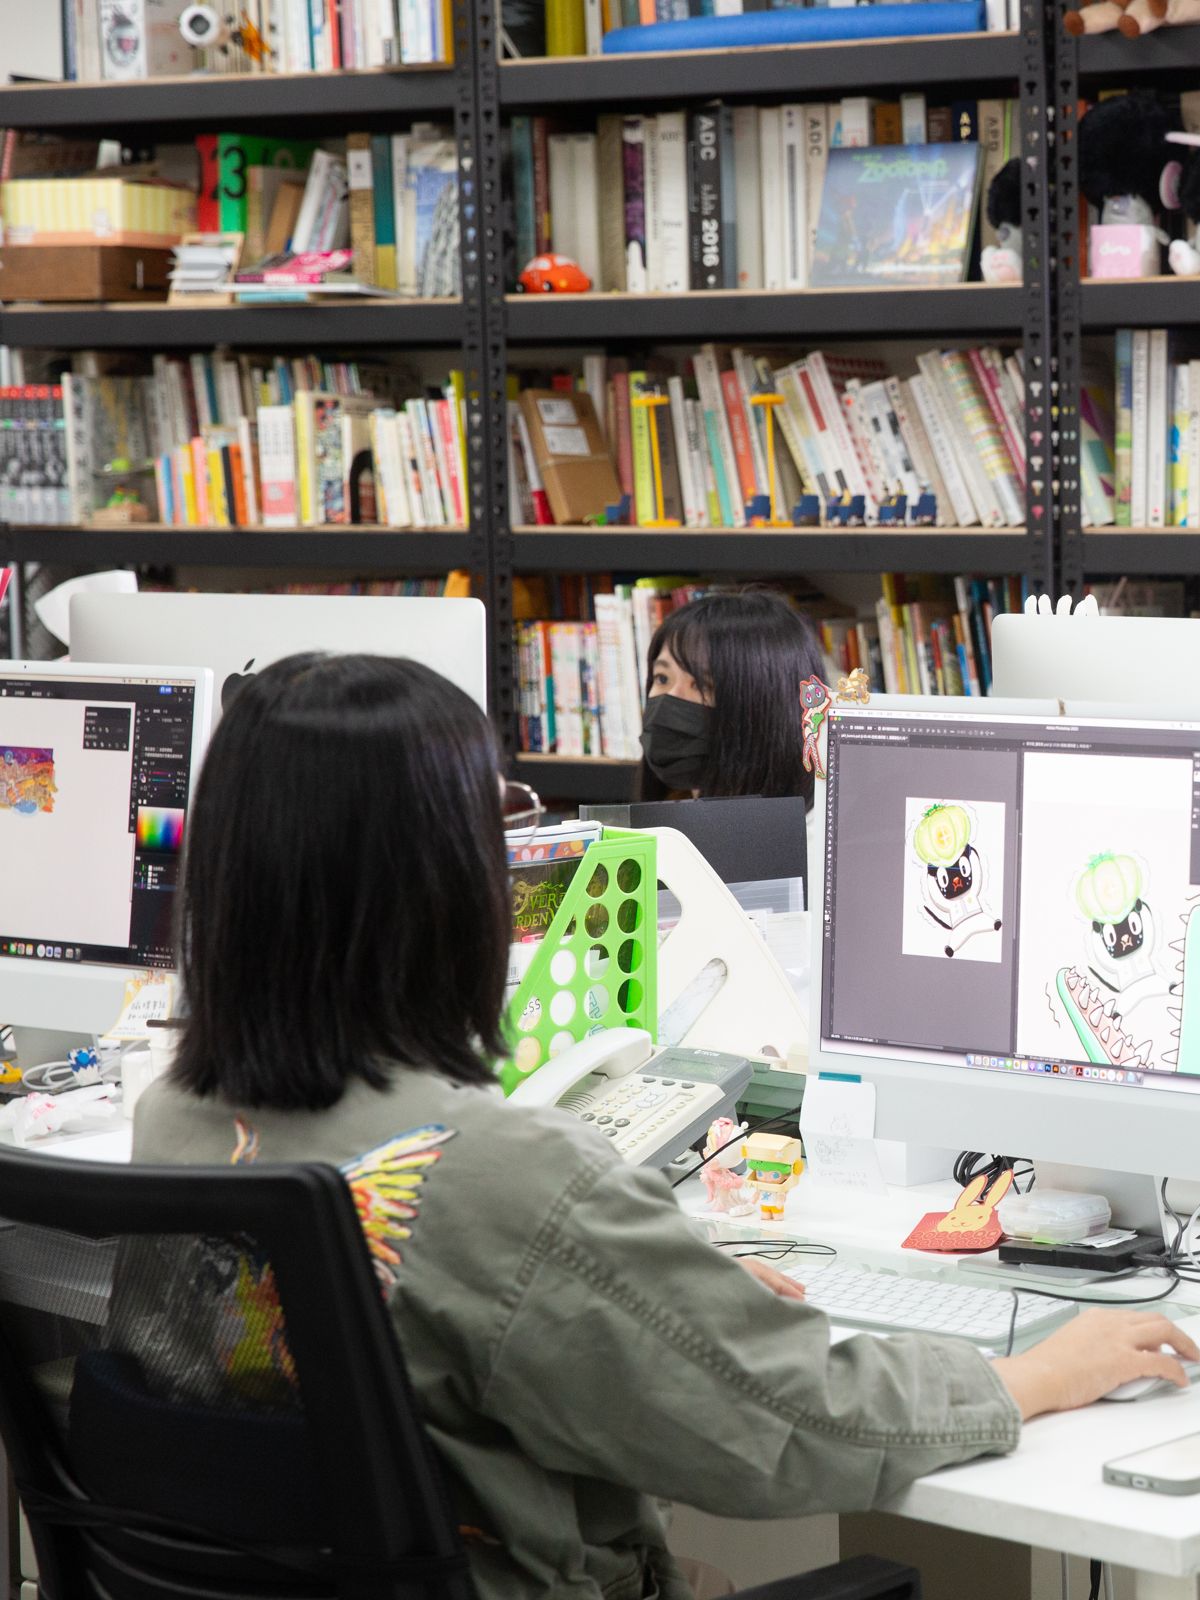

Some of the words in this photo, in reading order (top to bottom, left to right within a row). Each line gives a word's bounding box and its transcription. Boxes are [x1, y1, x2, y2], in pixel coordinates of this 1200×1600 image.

[699, 115, 716, 161] ADC
[809, 118, 822, 157] ADC
[702, 218, 720, 267] 2016
